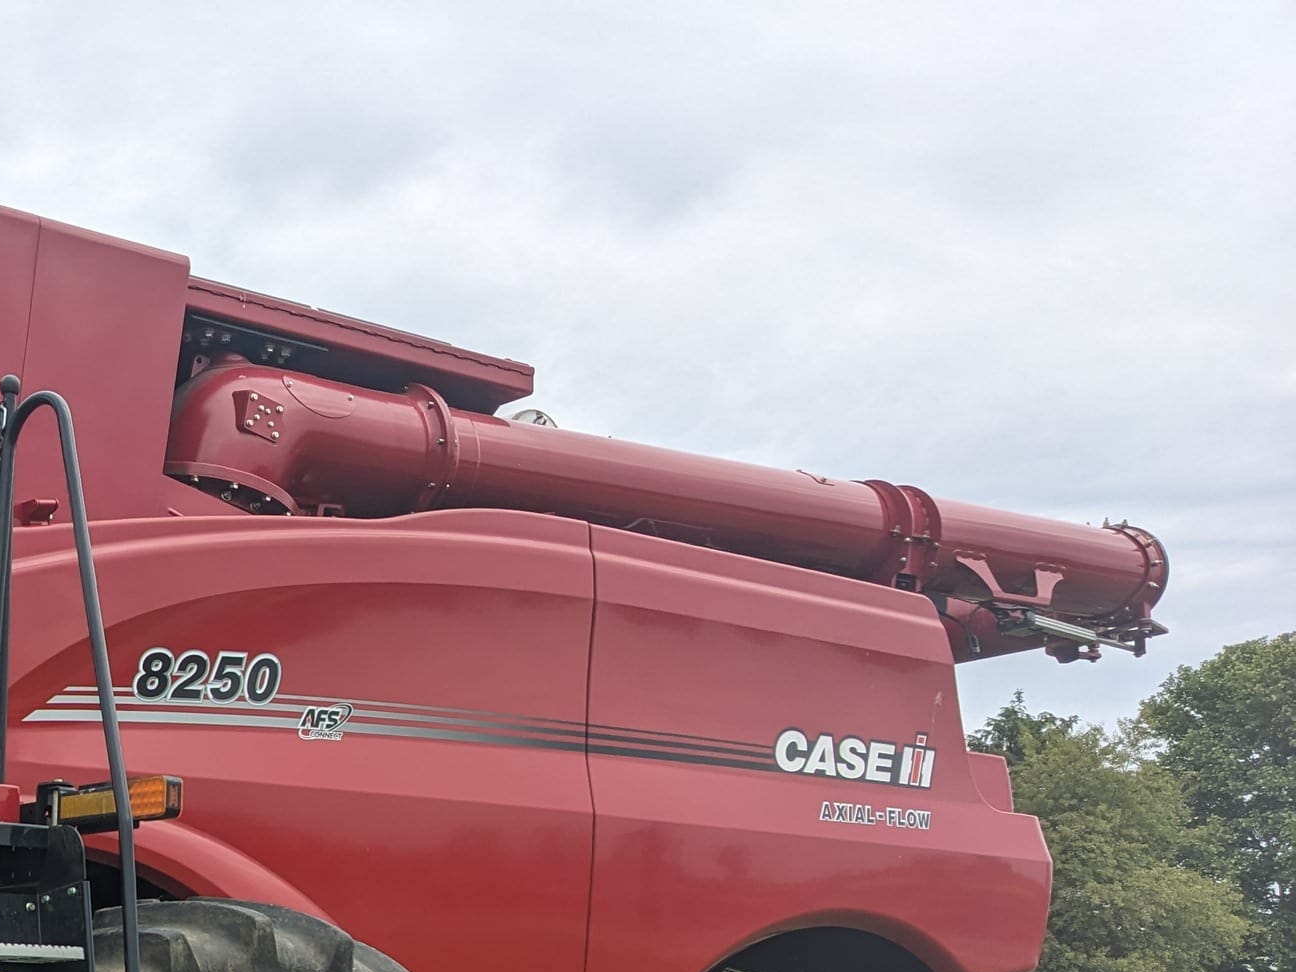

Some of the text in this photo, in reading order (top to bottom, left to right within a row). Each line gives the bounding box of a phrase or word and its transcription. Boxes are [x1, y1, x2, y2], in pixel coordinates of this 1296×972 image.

[133, 647, 282, 706] 8250
[299, 707, 341, 729] AFS
[309, 730, 343, 741] CONNECT
[774, 729, 936, 789] CASE IH
[819, 801, 932, 830] AXIAL-FLOW
